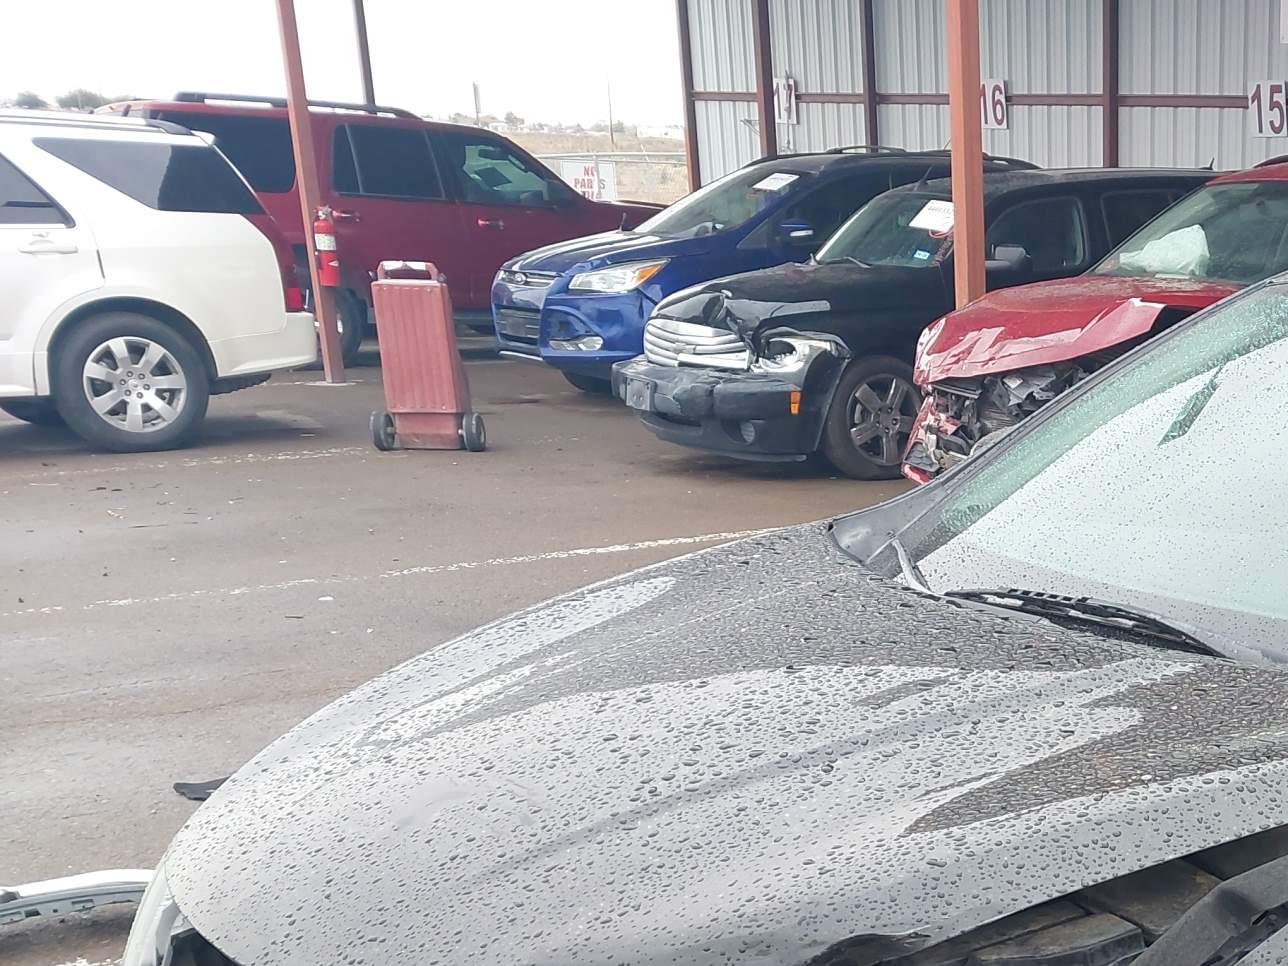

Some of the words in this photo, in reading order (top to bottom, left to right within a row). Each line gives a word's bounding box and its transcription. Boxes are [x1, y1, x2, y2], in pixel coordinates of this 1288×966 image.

[774, 82, 794, 120] 17
[980, 83, 1005, 126] 16
[1251, 84, 1285, 135] 15
[574, 178, 606, 190] PARS
